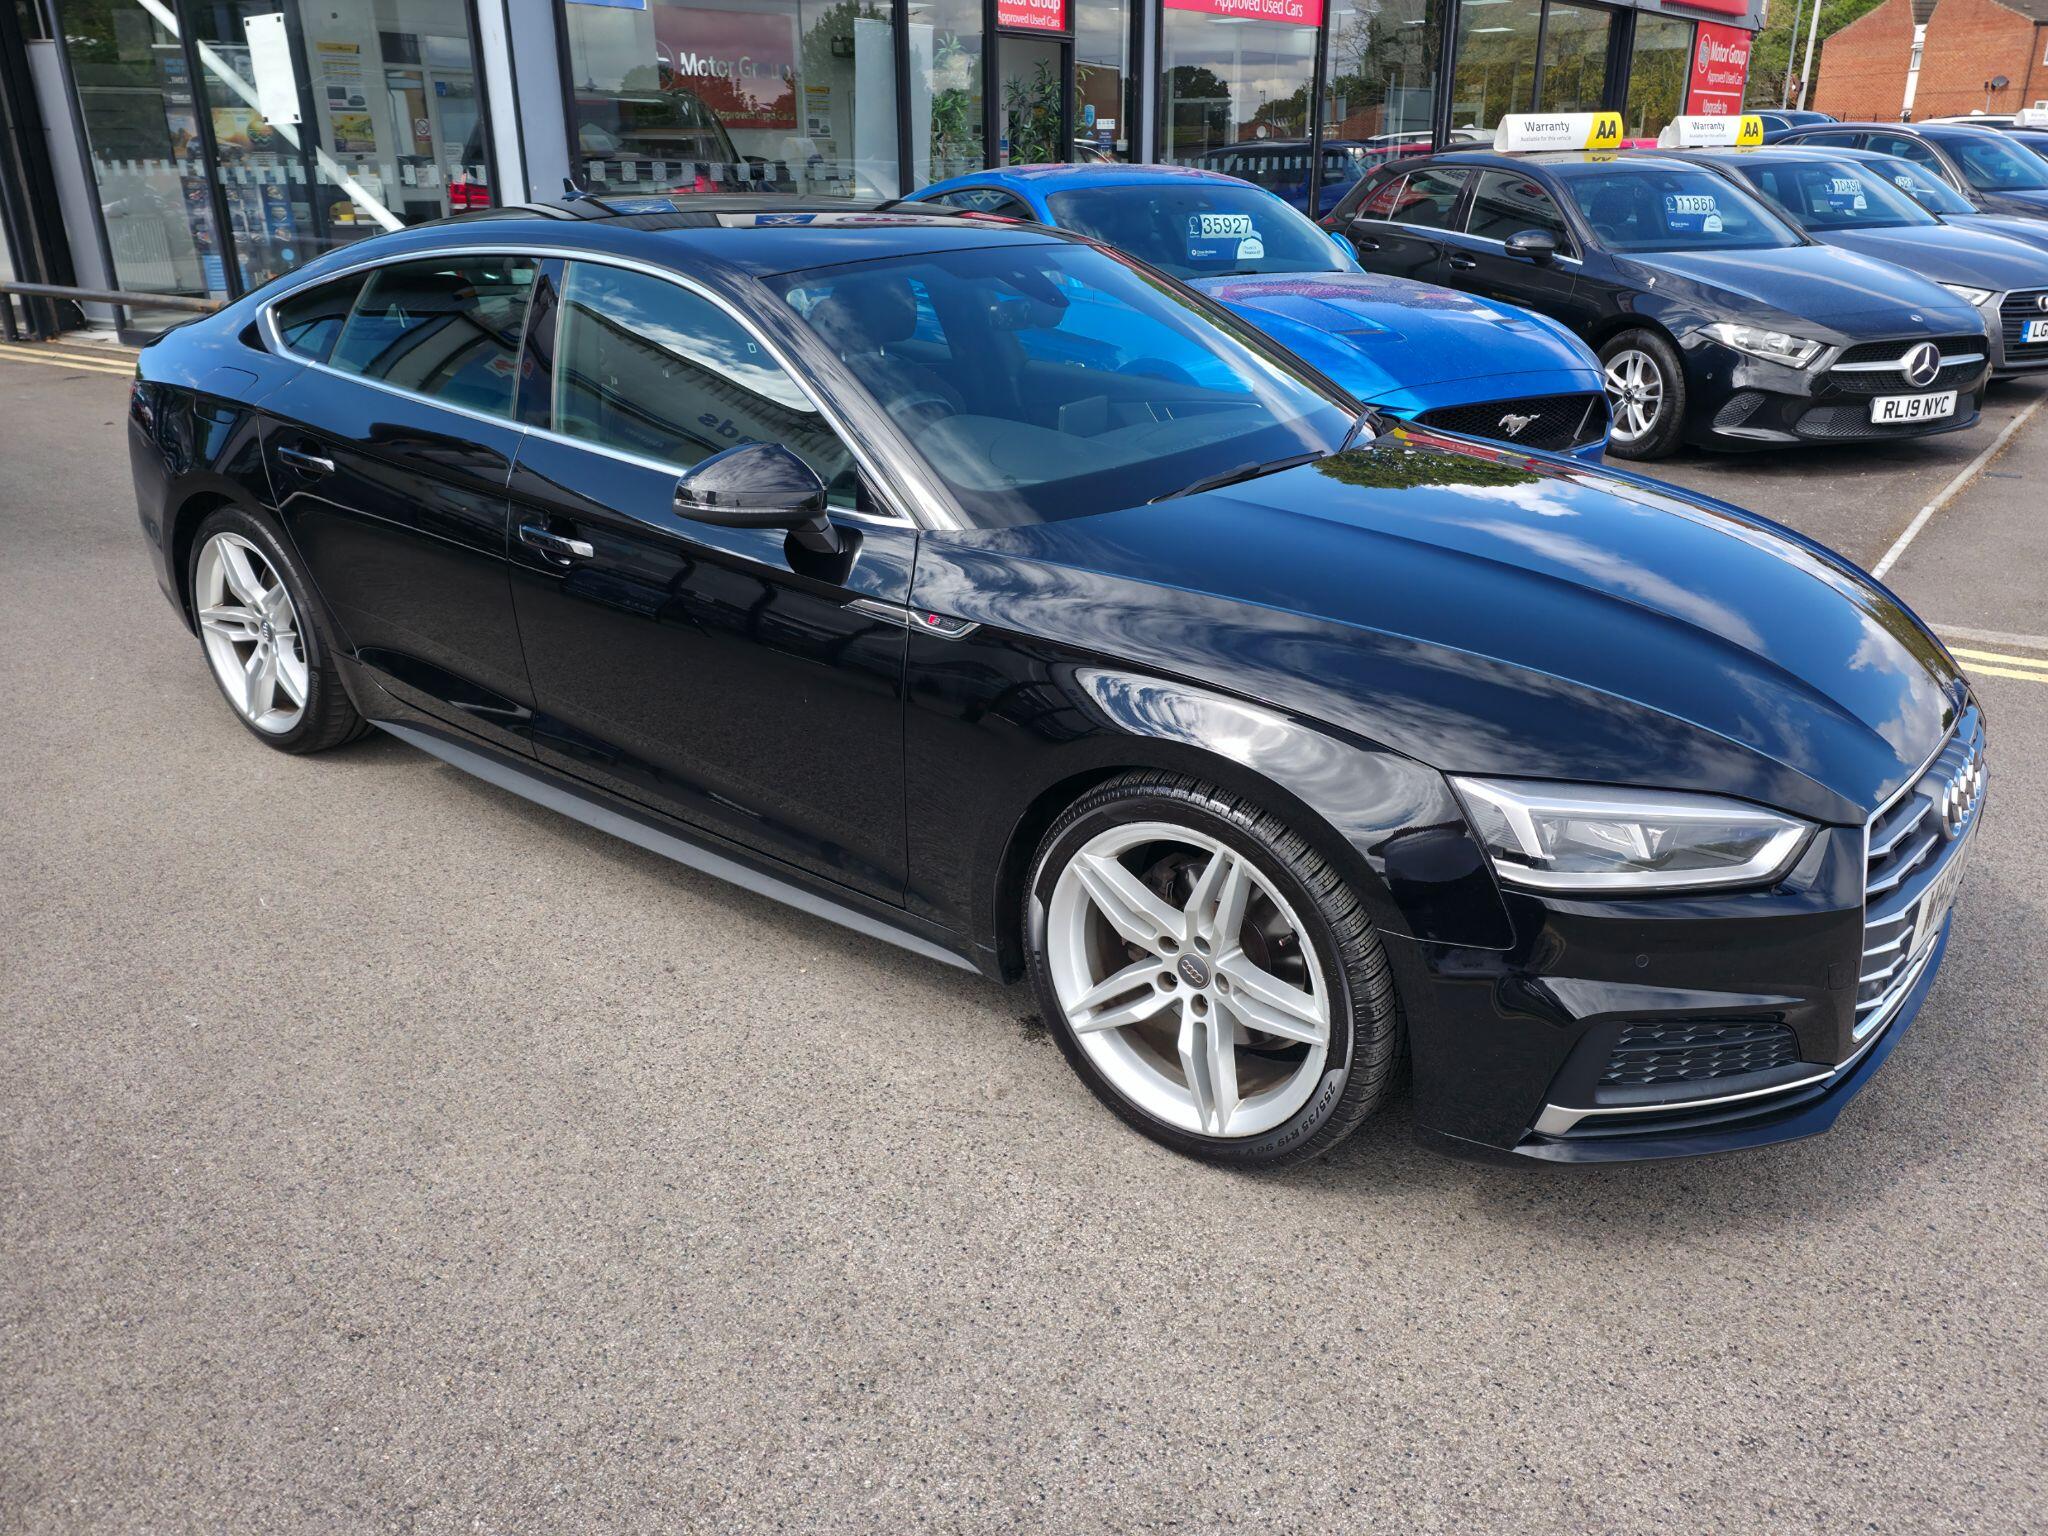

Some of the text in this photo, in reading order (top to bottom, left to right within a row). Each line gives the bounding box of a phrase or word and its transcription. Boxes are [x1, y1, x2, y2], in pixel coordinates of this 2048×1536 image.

[1261, 0, 1284, 14] Used
[1285, 0, 1303, 17] Cars
[1030, 14, 1046, 25] Used
[1046, 16, 1060, 27] Cars
[680, 52, 792, 80] Motor Gru
[1710, 42, 1746, 70] Motor Group
[1525, 120, 1617, 139] Warranty AA
[1692, 121, 1759, 137] Warranty AA
[1188, 216, 1250, 236] £35927
[1883, 396, 1949, 419] RL19 NYC
[1301, 1080, 1336, 1133] 255/35
[1278, 1127, 1301, 1147] R19
